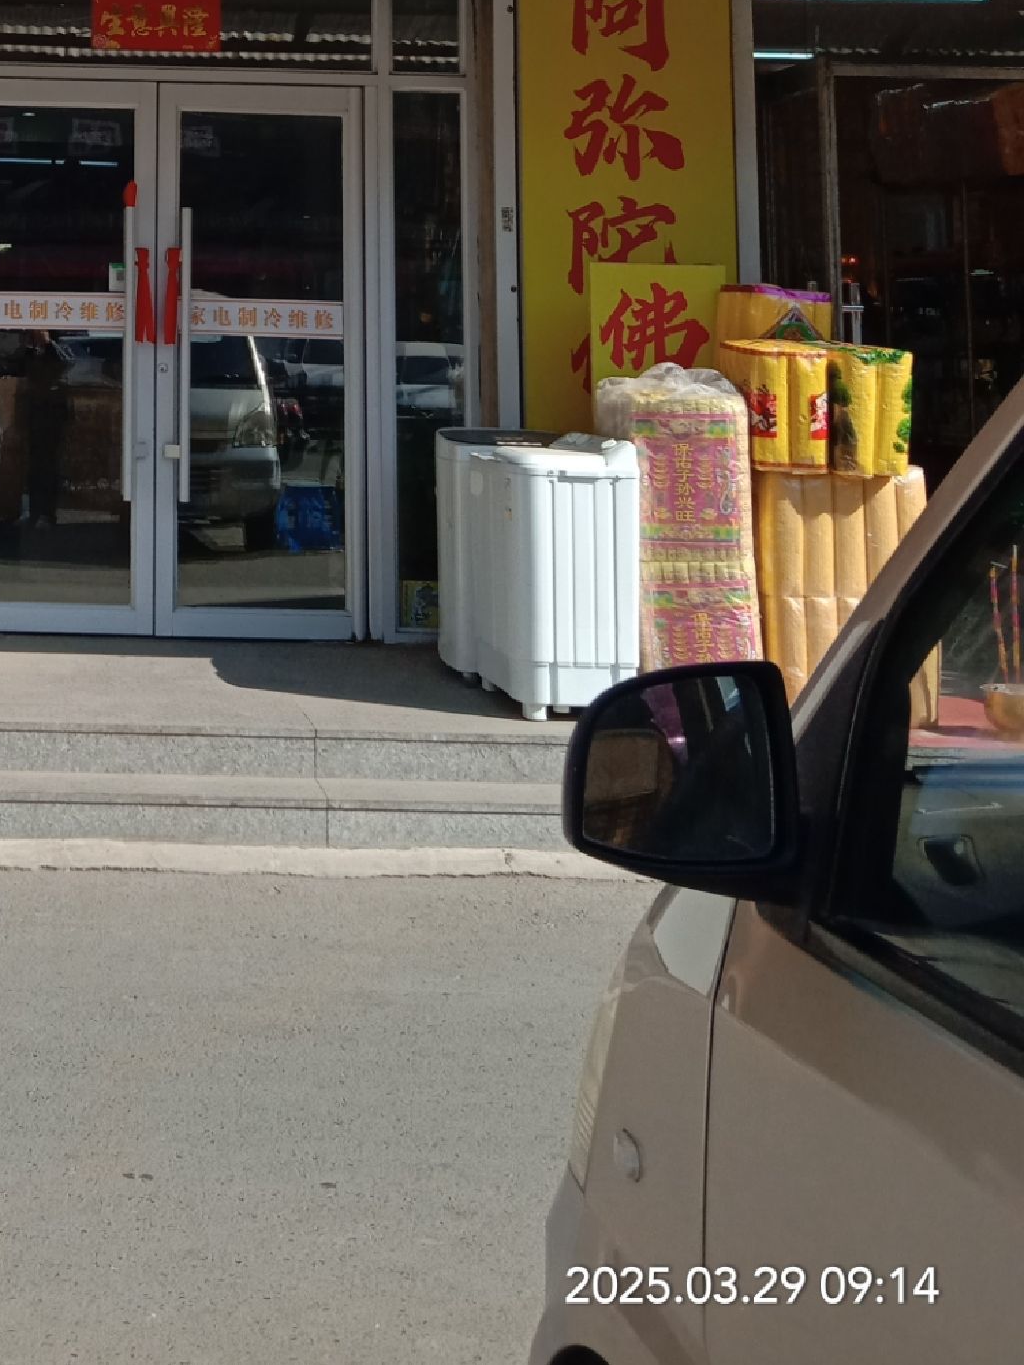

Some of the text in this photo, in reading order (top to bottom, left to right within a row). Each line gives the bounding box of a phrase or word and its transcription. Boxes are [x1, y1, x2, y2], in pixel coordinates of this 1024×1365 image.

[190, 304, 334, 331] 家电制冷维修
[599, 282, 710, 370] 佛
[672, 443, 696, 523] 保佑子孙兴旺
